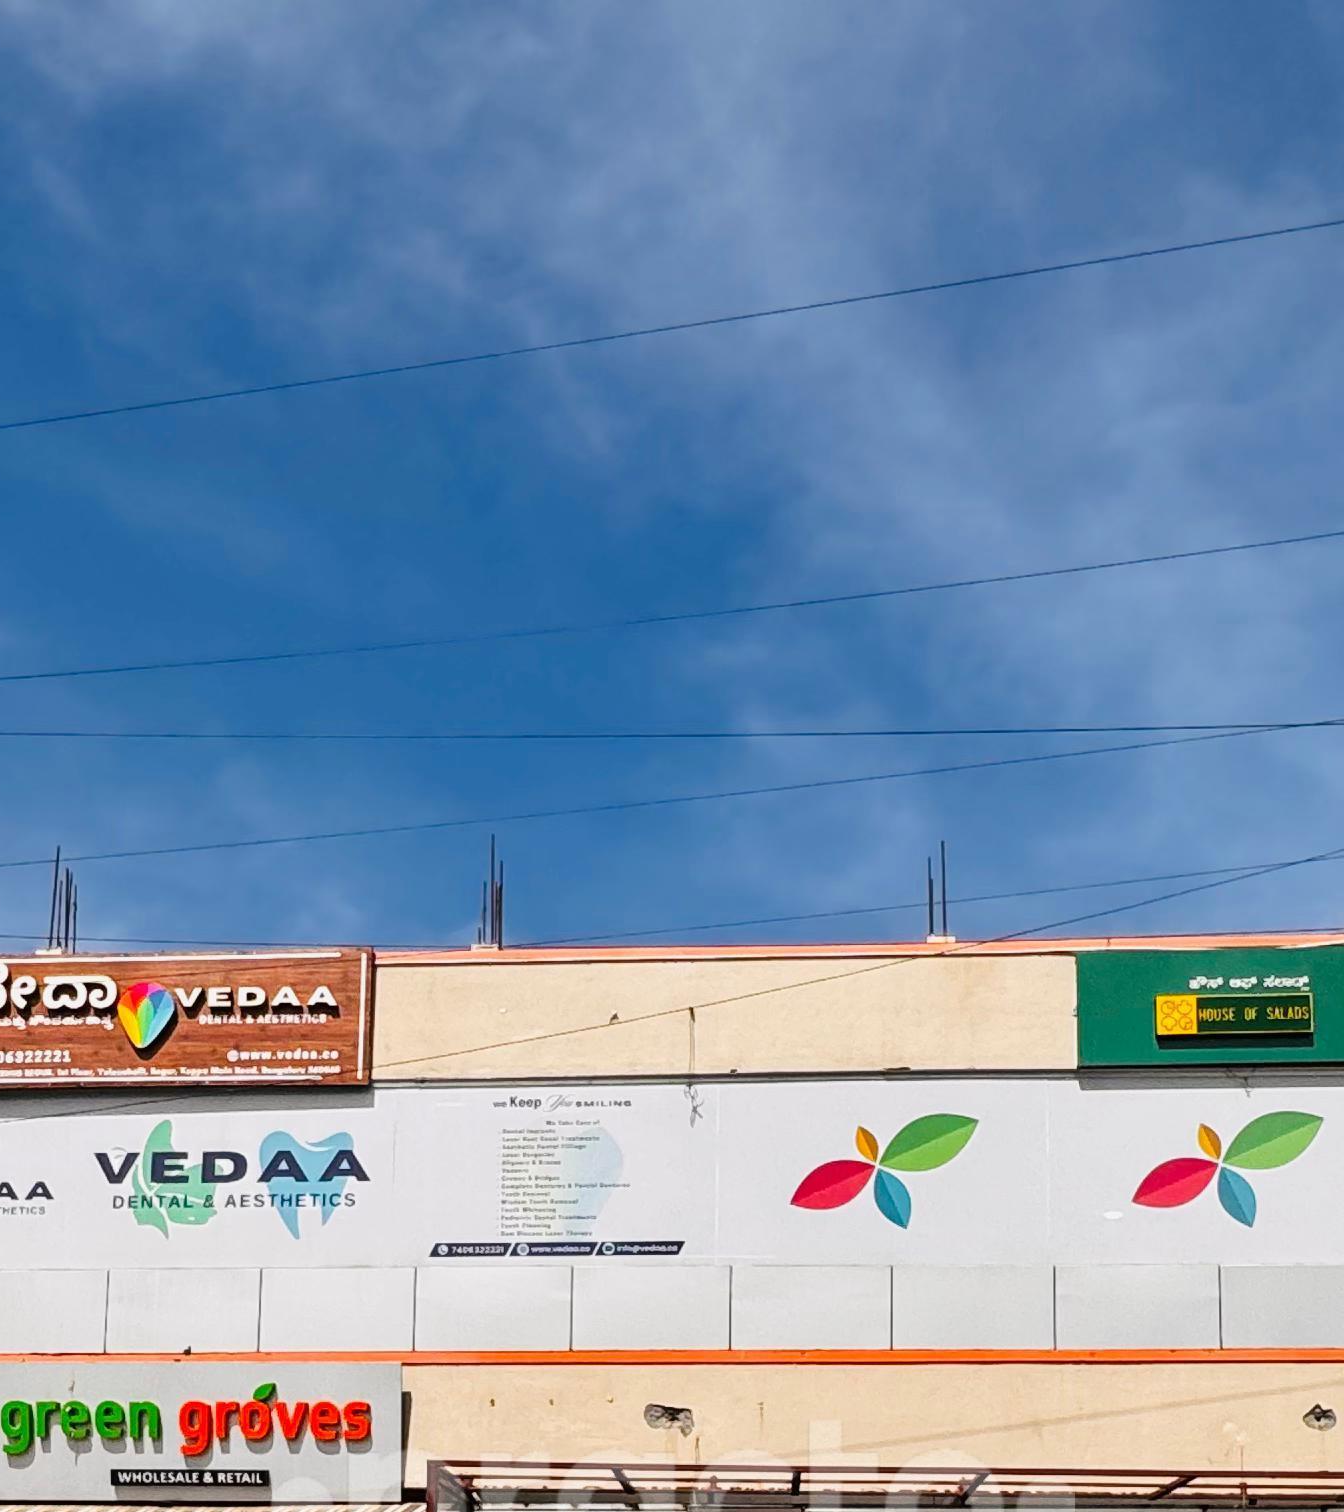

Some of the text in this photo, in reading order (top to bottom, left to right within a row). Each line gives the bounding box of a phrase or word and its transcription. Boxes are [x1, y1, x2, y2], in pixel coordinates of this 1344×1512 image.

[174, 985, 337, 1008] VEDAA
[199, 1014, 243, 1024] DENTAL
[1199, 1006, 1309, 1021] HOUSE OF SALADS
[510, 1096, 542, 1109] Keep
[94, 1149, 371, 1185] VEDAA
[112, 1192, 356, 1209] DENTAL & AESTHETICS
[0, 1398, 372, 1456] green groves
[117, 1471, 264, 1485] WHOLESALE & RETAIL
